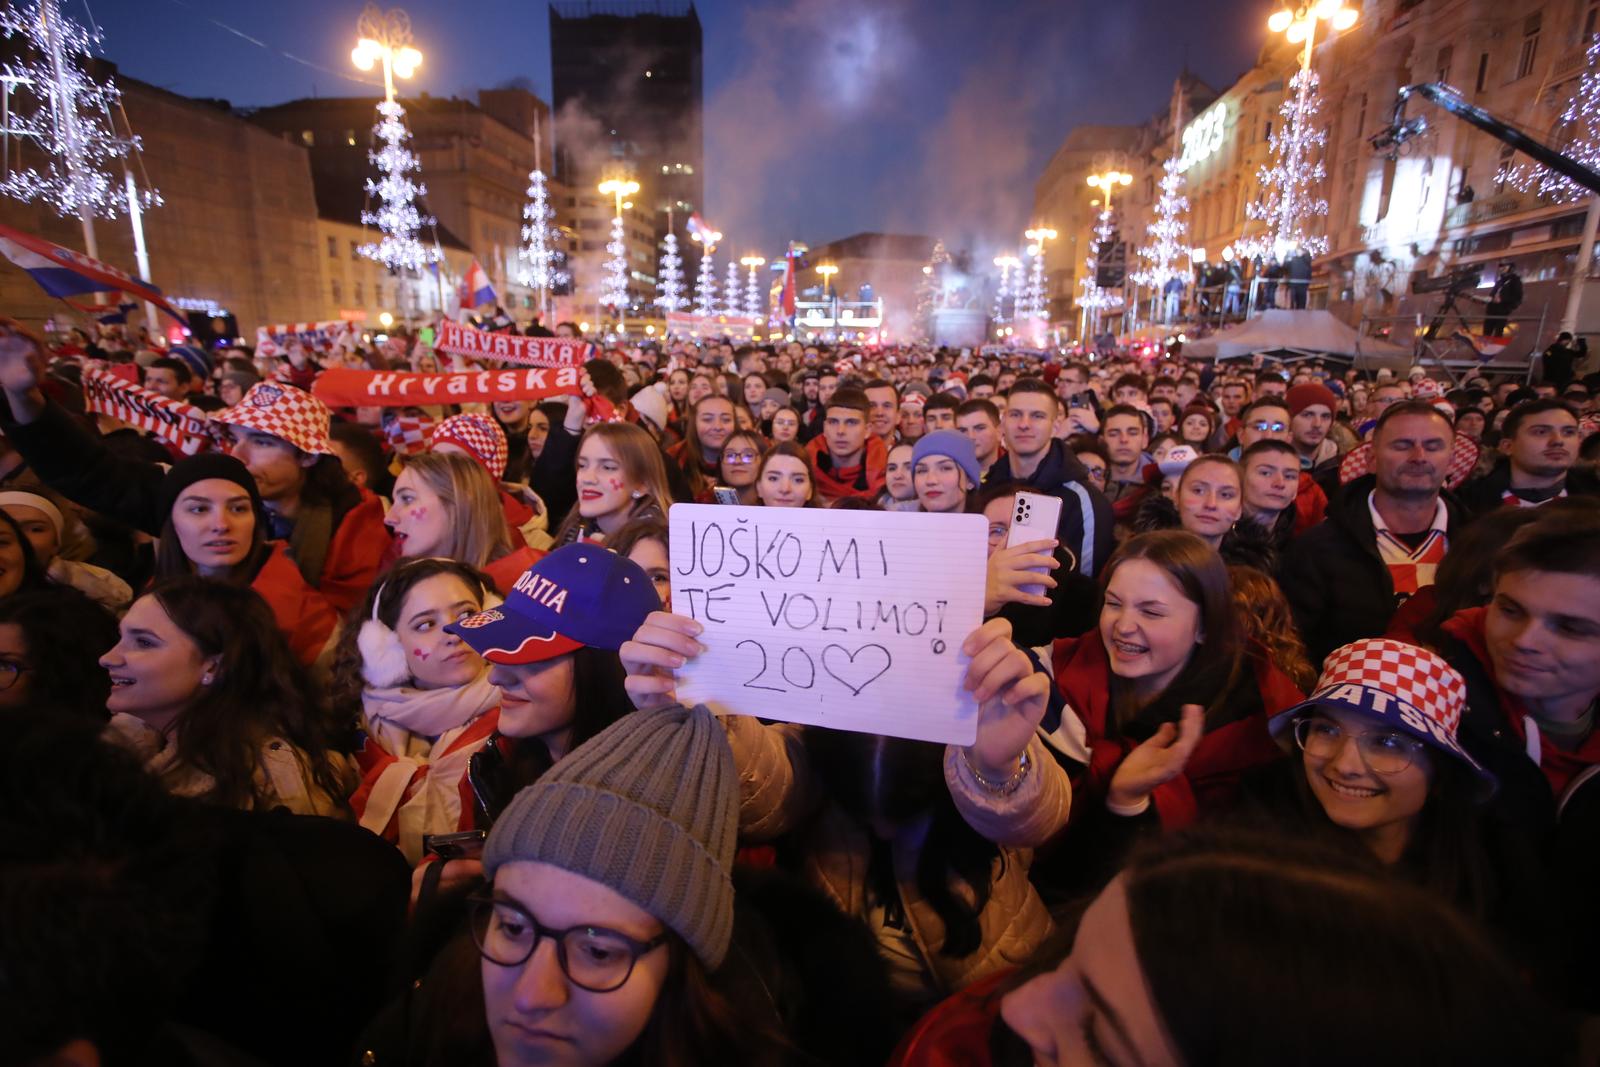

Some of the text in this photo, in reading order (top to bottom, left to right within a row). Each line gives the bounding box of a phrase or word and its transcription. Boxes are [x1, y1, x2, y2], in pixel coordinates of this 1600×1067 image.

[1178, 102, 1226, 173] 2023
[449, 329, 574, 361] HRVATSKA
[367, 367, 577, 396] Hrvatska
[677, 518, 802, 580] JOŠKO
[513, 570, 568, 614] OATIA
[680, 583, 735, 623] TE
[736, 639, 815, 693] 20
